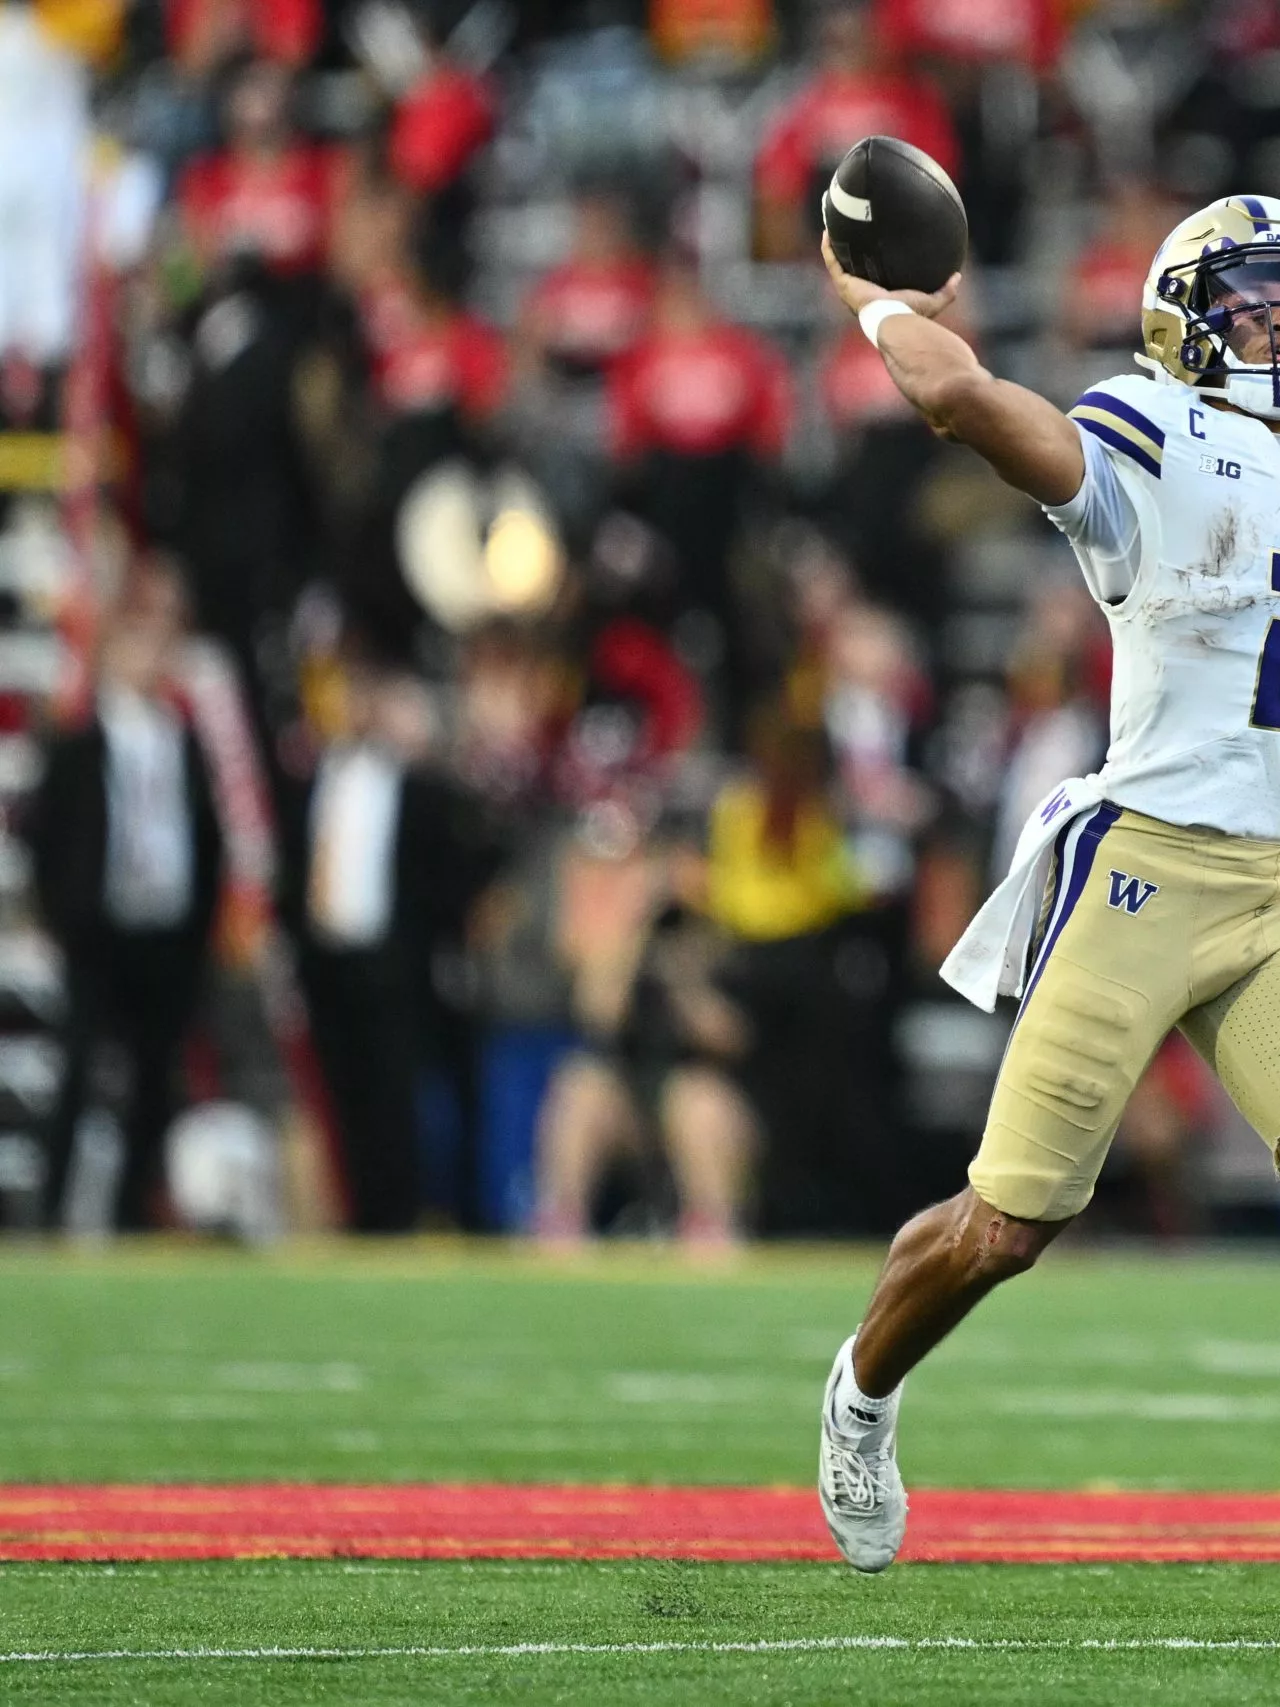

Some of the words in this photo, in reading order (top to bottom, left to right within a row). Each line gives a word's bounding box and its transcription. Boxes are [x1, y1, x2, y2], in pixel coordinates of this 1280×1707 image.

[1188, 407, 1206, 440] C
[1040, 786, 1073, 826] W
[1106, 868, 1160, 918] W
